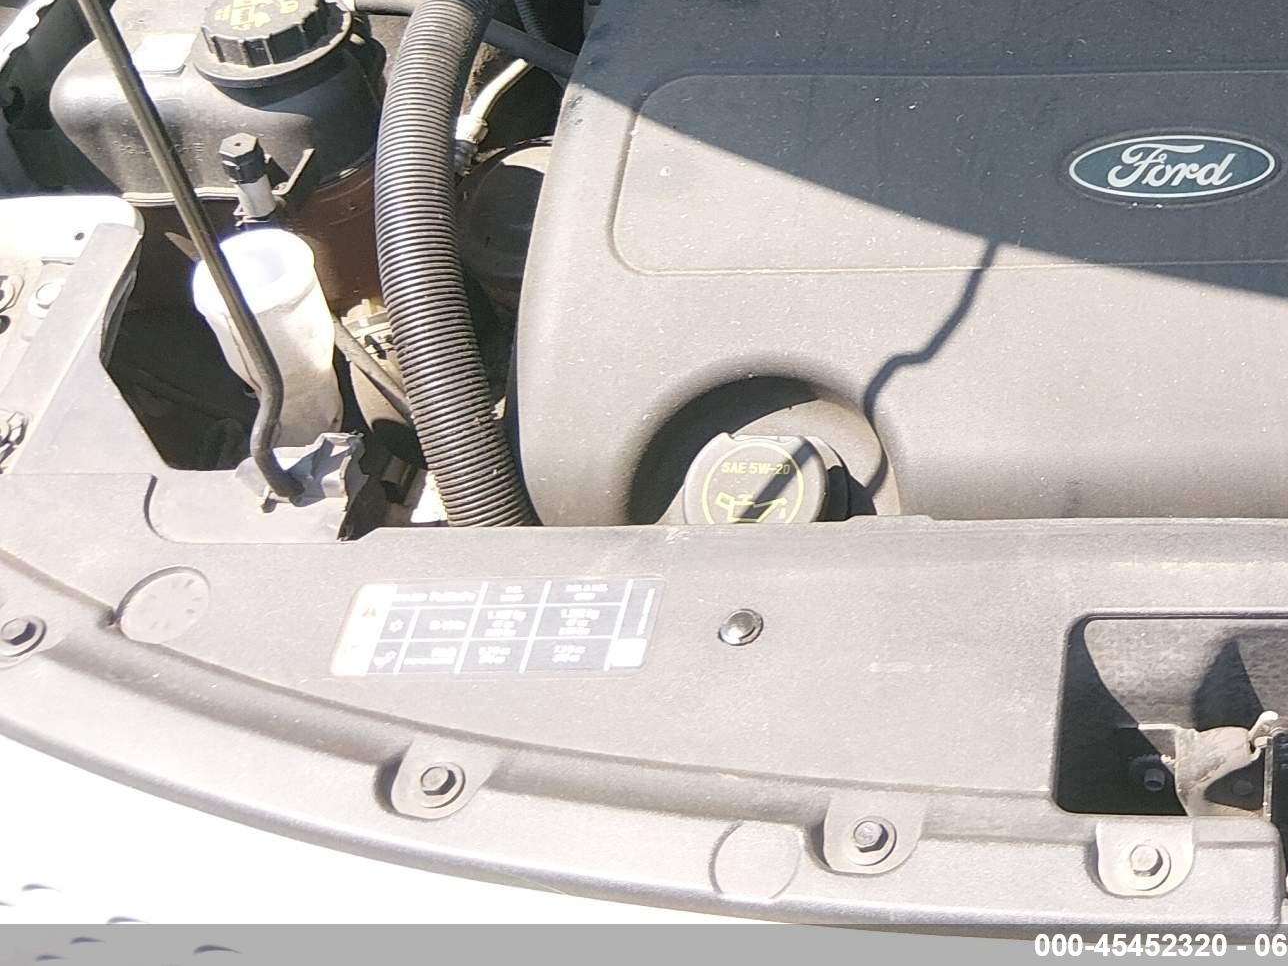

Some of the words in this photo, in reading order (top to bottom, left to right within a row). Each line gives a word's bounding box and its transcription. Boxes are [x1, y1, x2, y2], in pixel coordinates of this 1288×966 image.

[1107, 143, 1237, 188] Ford
[720, 461, 746, 474] SAE
[748, 461, 791, 475] 5W-20
